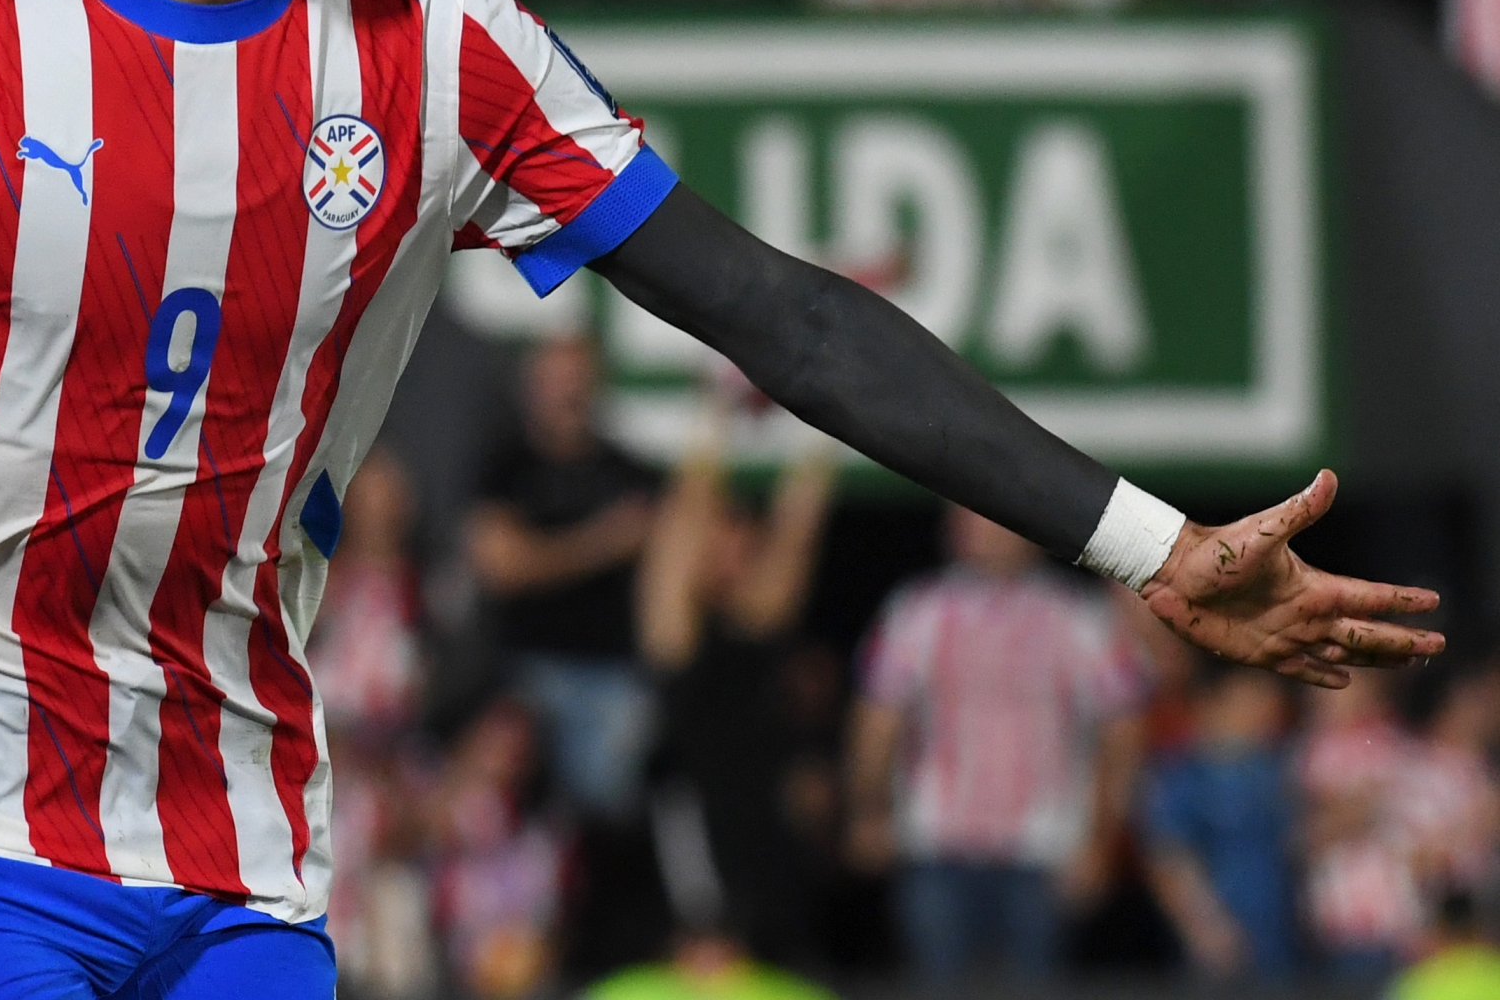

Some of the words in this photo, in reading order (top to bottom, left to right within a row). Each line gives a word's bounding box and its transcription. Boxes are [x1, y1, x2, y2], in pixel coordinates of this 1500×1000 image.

[326, 124, 357, 143] APF
[322, 207, 360, 224] PARAGUAY
[144, 286, 223, 461] 9
